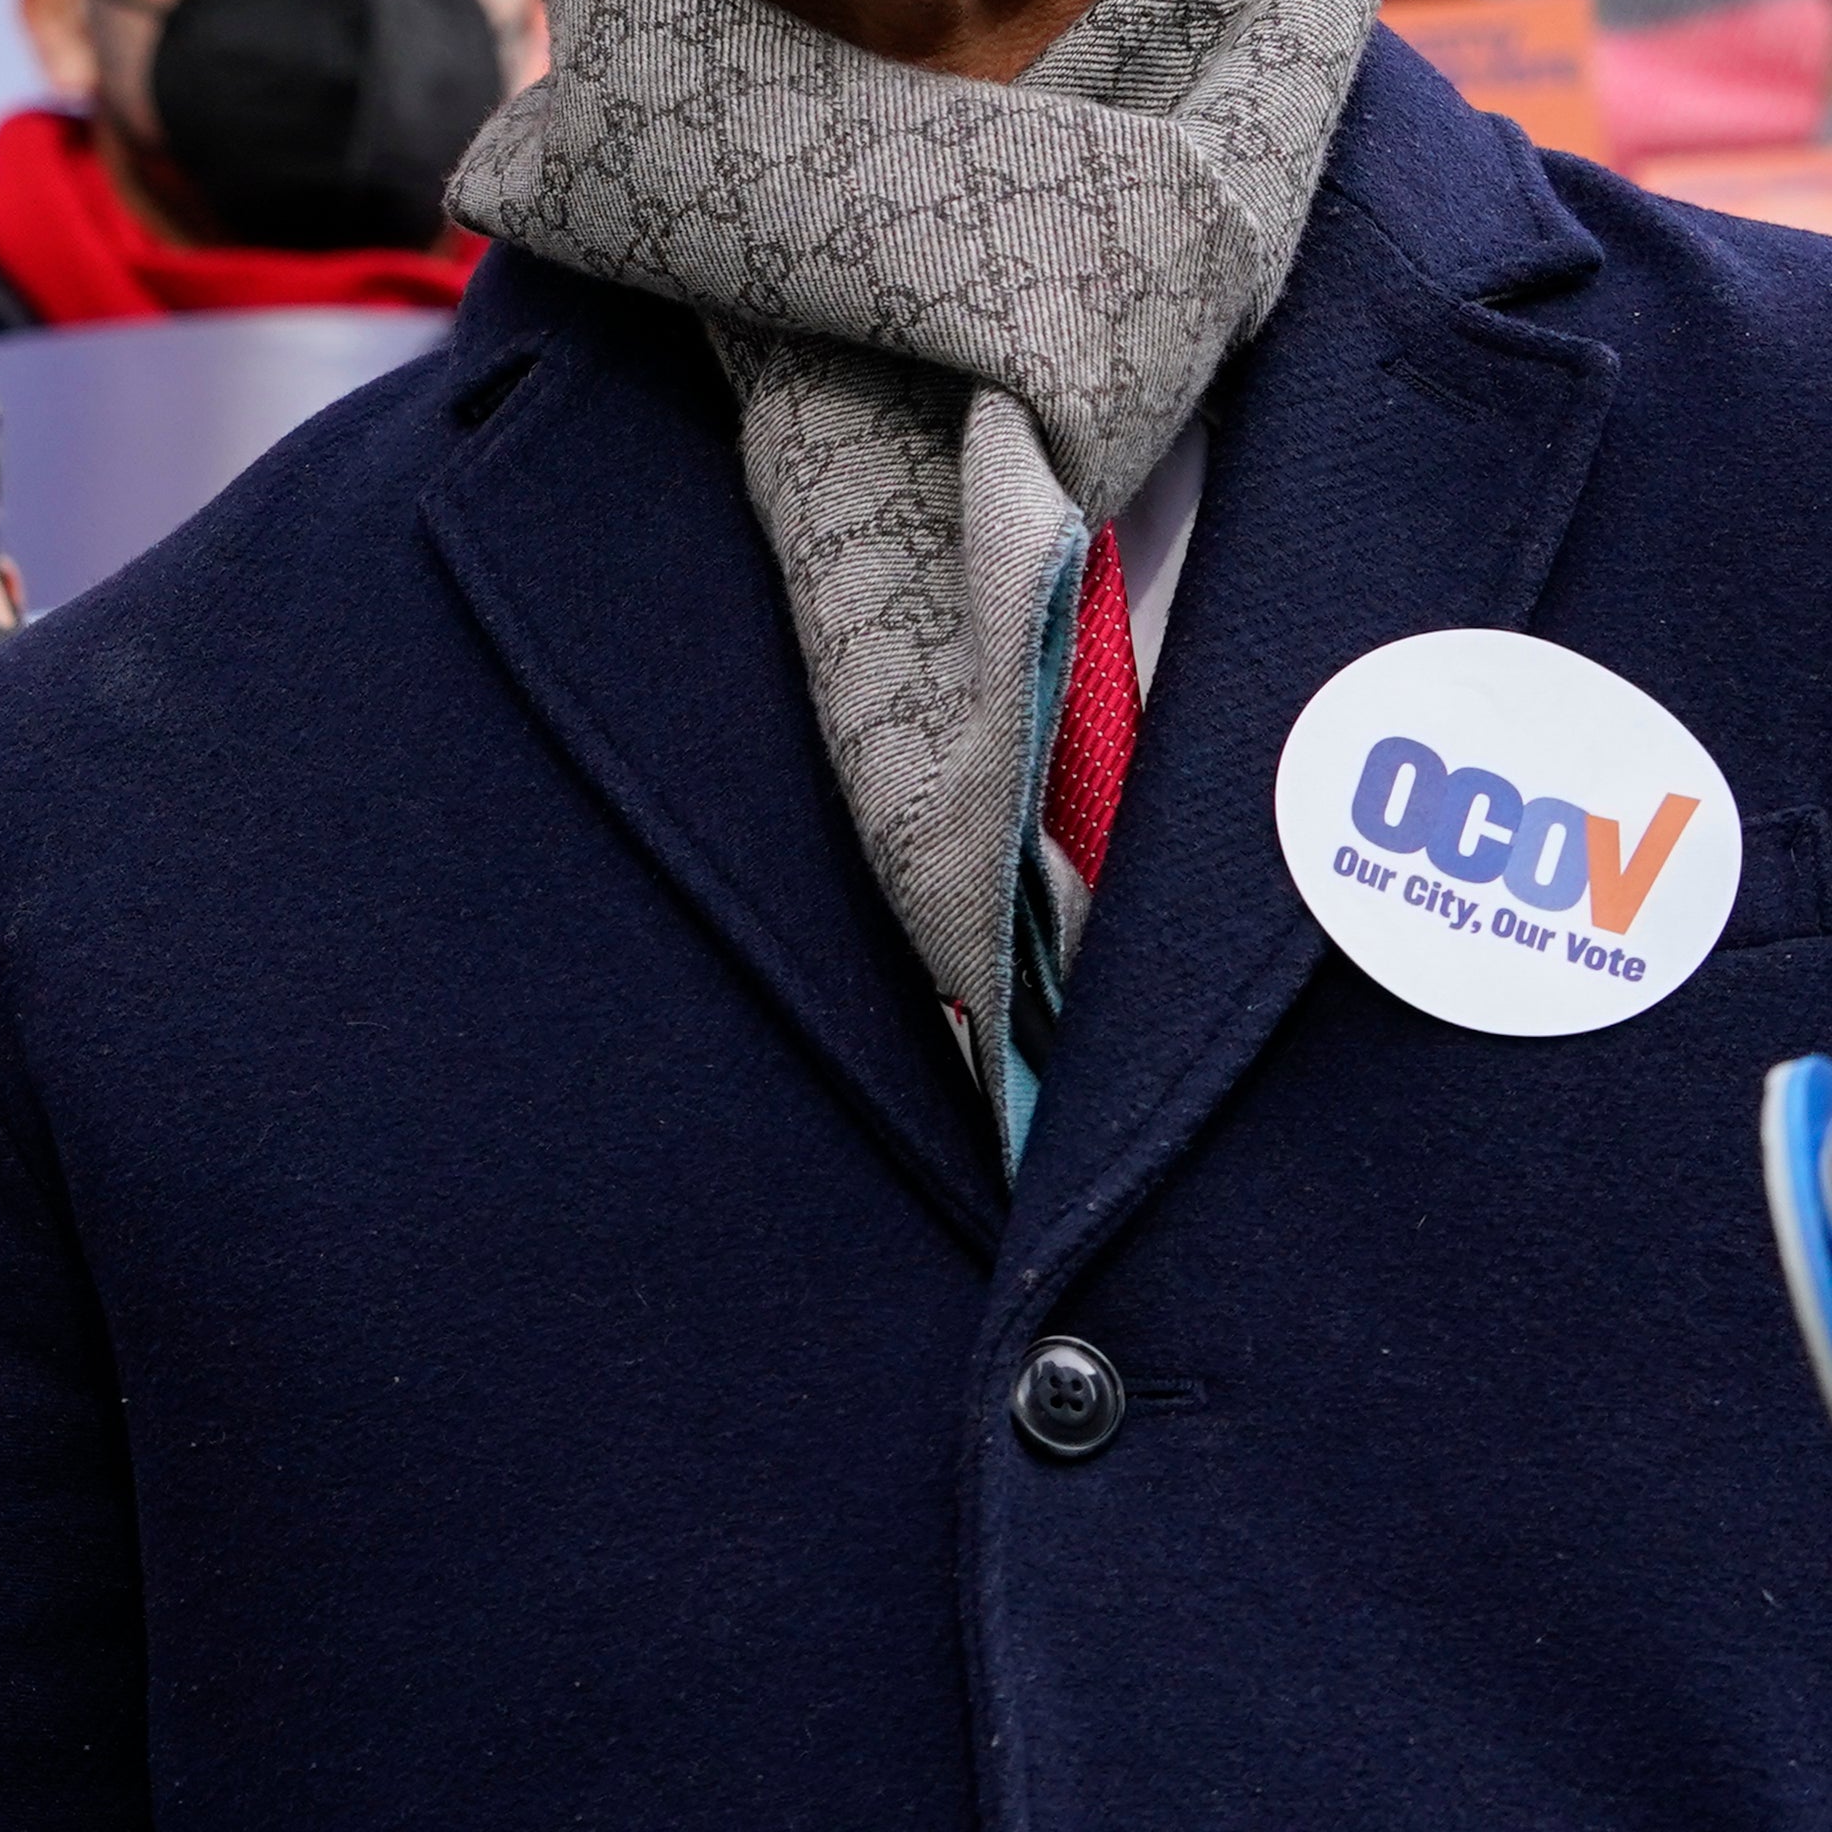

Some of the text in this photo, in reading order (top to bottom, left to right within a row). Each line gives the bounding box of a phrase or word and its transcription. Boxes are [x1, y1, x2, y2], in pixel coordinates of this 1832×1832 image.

[1333, 845, 1648, 983] Our City, Our Vote
[1351, 736, 1701, 936] OCOV
